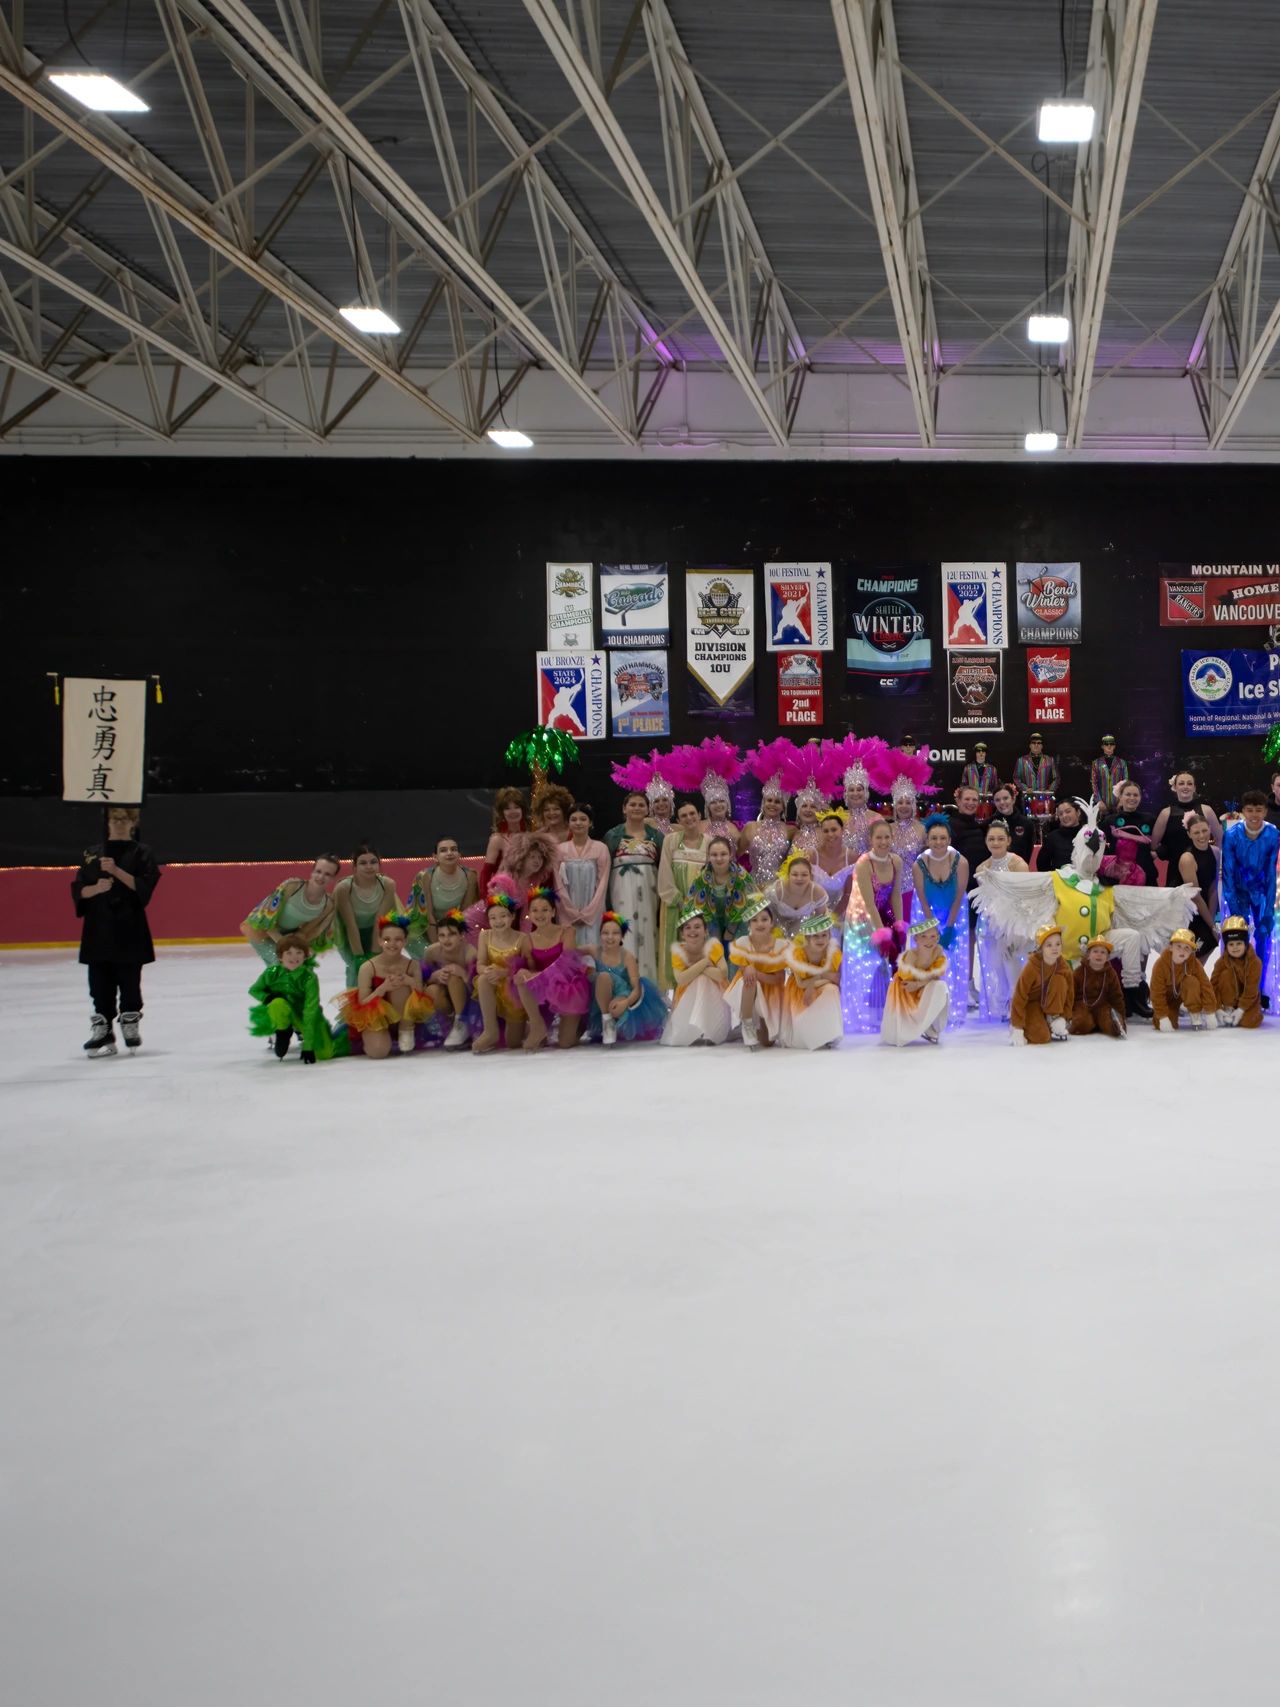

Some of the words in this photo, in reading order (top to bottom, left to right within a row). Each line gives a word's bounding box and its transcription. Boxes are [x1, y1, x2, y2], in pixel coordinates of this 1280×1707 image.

[769, 568, 780, 577] 10U
[782, 568, 811, 577] FESTIVAL
[947, 571, 957, 579] 12U
[960, 571, 988, 579] FESTIVAL
[1191, 564, 1262, 575] MOUNTAIN
[857, 578, 918, 592] CHAMPIONS
[1043, 581, 1075, 596] Bend
[1231, 583, 1279, 599] HOME
[608, 587, 664, 608] Cascade
[1022, 592, 1066, 608] Winter
[875, 605, 902, 614] SEATTLE
[1035, 608, 1063, 616] CLASSIC
[1174, 594, 1203, 618] RANGERS
[697, 607, 718, 618] ICE
[720, 607, 745, 618] CUP
[816, 582, 828, 646] CHAMPIONS
[992, 581, 1003, 645] CHAMPIONS
[550, 616, 592, 629] CHAMPIONS
[855, 615, 922, 633] WINTER
[608, 636, 621, 645] 10U
[623, 634, 665, 645] CHAMPIONS
[1020, 627, 1079, 640] CHAMPIONS
[695, 643, 746, 651] DIVISION
[541, 656, 553, 666] 10U
[556, 656, 585, 666] BRONZE
[695, 653, 747, 661] CHAMPIONS
[710, 664, 731, 673] 10U
[1238, 682, 1265, 699] Ice
[591, 669, 602, 737] CHAMPIONS
[792, 698, 809, 710] 2nd
[1043, 697, 1056, 708] 1st
[786, 711, 816, 722] PLACE
[1036, 709, 1064, 719] PLACE
[632, 717, 665, 732] PLACE
[86, 685, 118, 800] 忠勇真
